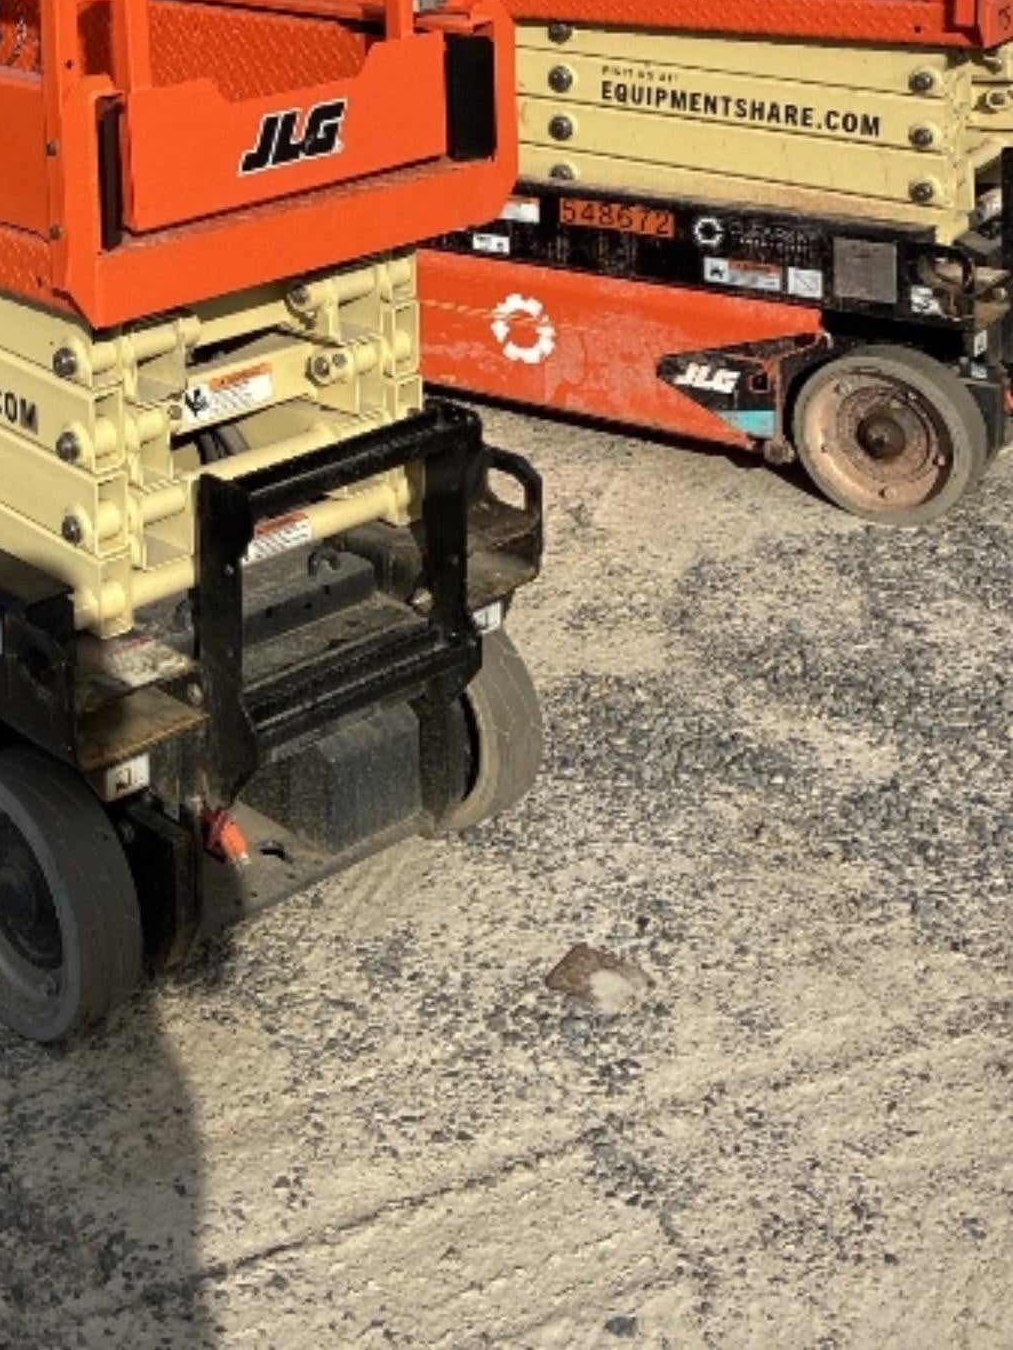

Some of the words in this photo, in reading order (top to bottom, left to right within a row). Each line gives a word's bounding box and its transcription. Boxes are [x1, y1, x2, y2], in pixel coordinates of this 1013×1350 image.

[601, 80, 881, 137] EQUIPMENTSHARE.COM
[237, 97, 348, 177] JLG
[562, 200, 670, 236] 548672
[673, 362, 741, 394] JLG
